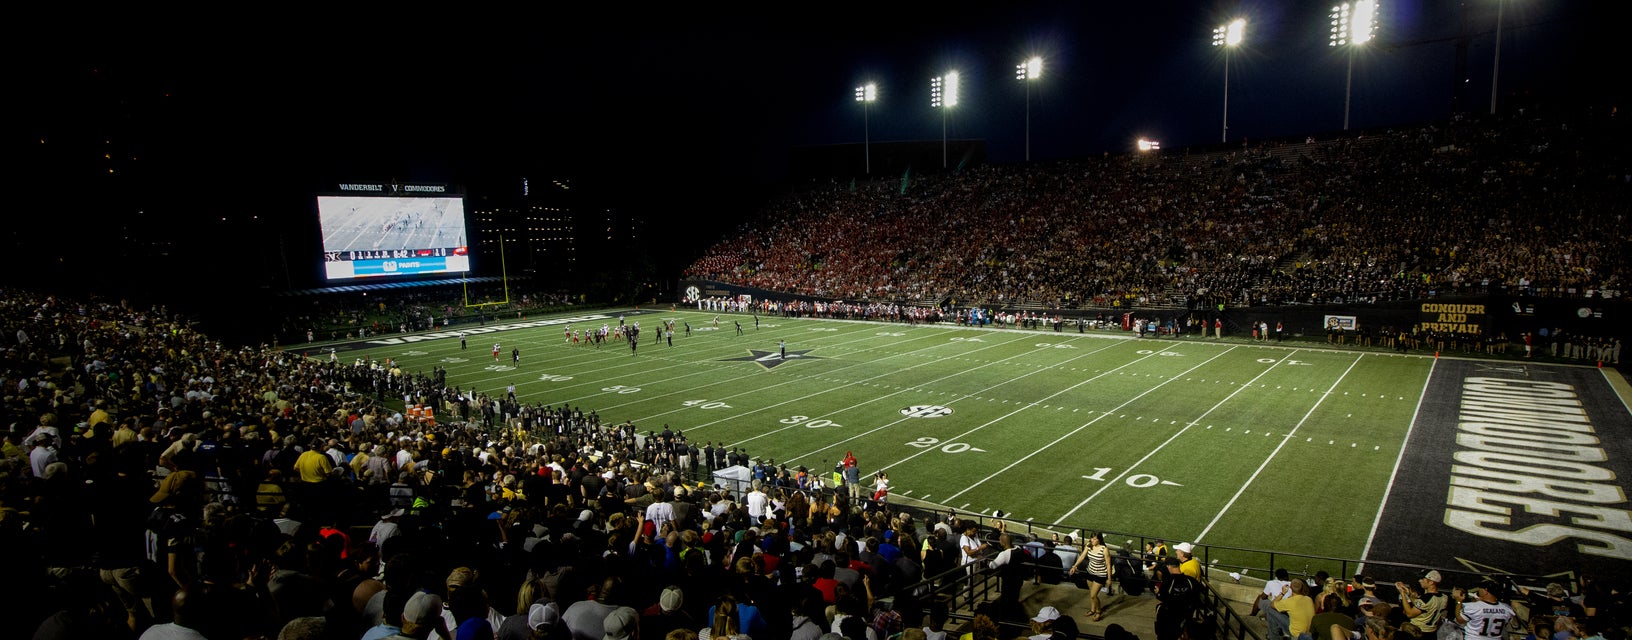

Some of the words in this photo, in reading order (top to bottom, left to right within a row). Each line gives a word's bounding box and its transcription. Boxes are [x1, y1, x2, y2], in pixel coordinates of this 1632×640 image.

[686, 286, 700, 301] SEC
[1421, 303, 1485, 314] CONQUER
[1437, 313, 1467, 323] AND
[682, 399, 726, 409] 40
[779, 415, 832, 429] 30
[904, 436, 971, 454] 20
[1443, 377, 1632, 560] COMMODORES
[1081, 467, 1160, 488] 10
[1480, 618, 1505, 637] 13
